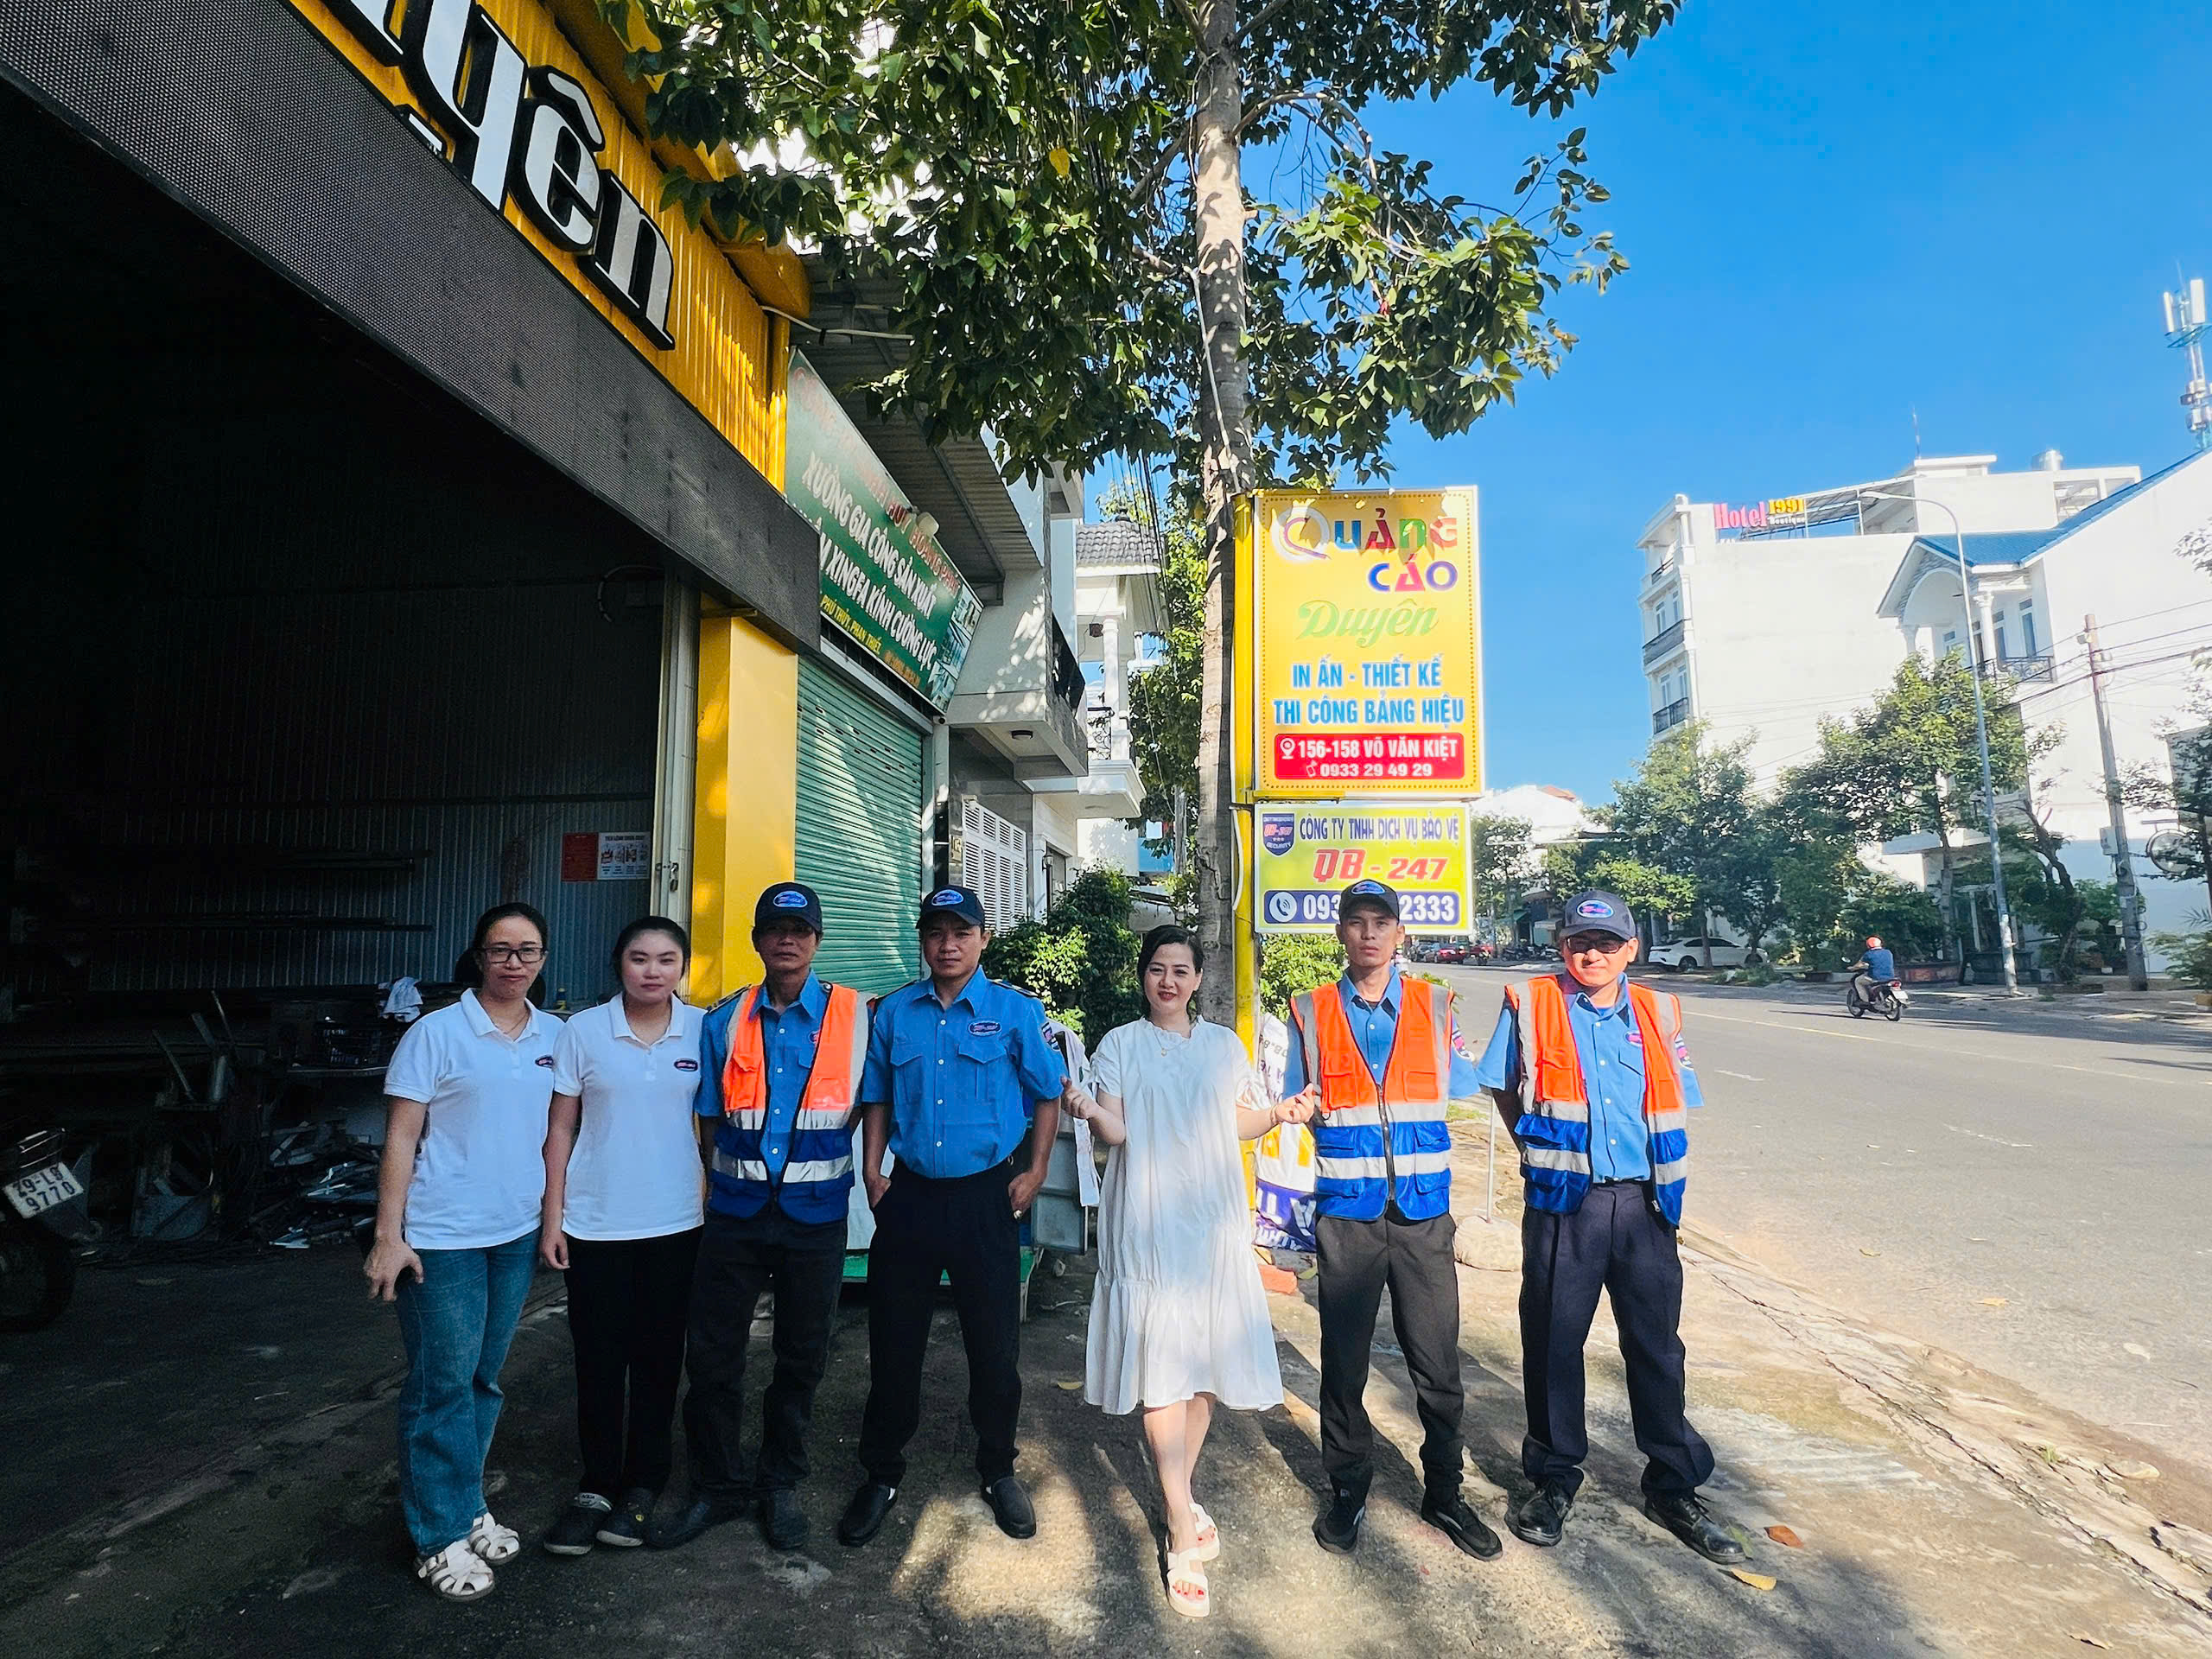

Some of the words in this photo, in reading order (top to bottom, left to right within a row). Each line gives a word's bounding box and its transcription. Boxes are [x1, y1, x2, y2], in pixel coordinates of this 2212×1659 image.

[1713, 501, 1768, 529] Hotel
[1769, 498, 1805, 514] 1991
[802, 450, 853, 527] XƯỞNG
[849, 505, 871, 550] GIA
[868, 526, 899, 579] CÔNG
[893, 556, 918, 600] SẢN
[910, 576, 937, 620] XUẤT
[1368, 553, 1459, 593] CÁO
[825, 544, 871, 609] XINGFA
[865, 584, 896, 632] KÍNH
[890, 610, 924, 658] CƯỜNG
[917, 638, 938, 671] LỰC
[1296, 598, 1440, 649] Duyên
[1293, 664, 1311, 687] IN
[1318, 653, 1343, 687] ẤN
[1362, 653, 1411, 687] THIẾT
[1418, 653, 1444, 687] KẾ
[1274, 700, 1300, 724] THI
[1307, 695, 1358, 724] CÔNG
[1364, 690, 1415, 724] BẢNG
[1421, 692, 1465, 729] HIỆU
[1298, 740, 1360, 759] 156-158
[1363, 737, 1383, 758] VÕ
[1388, 736, 1420, 758] VĂN
[1423, 736, 1458, 761] KIỆT
[1319, 764, 1359, 777] 0933
[1363, 764, 1383, 777] 29
[1388, 764, 1408, 777] 49
[1412, 764, 1433, 777] 29
[1300, 813, 1328, 840] CÔNG
[1332, 817, 1344, 840] TY
[1348, 817, 1374, 840] TNHH
[1377, 817, 1400, 846] DỊCH
[1403, 817, 1419, 846] VỤ
[1421, 811, 1442, 840] BẢO
[1446, 813, 1459, 847] VỆ
[1313, 849, 1367, 882] QB
[1387, 858, 1448, 880] 247
[26, 1181, 76, 1211] 9770
